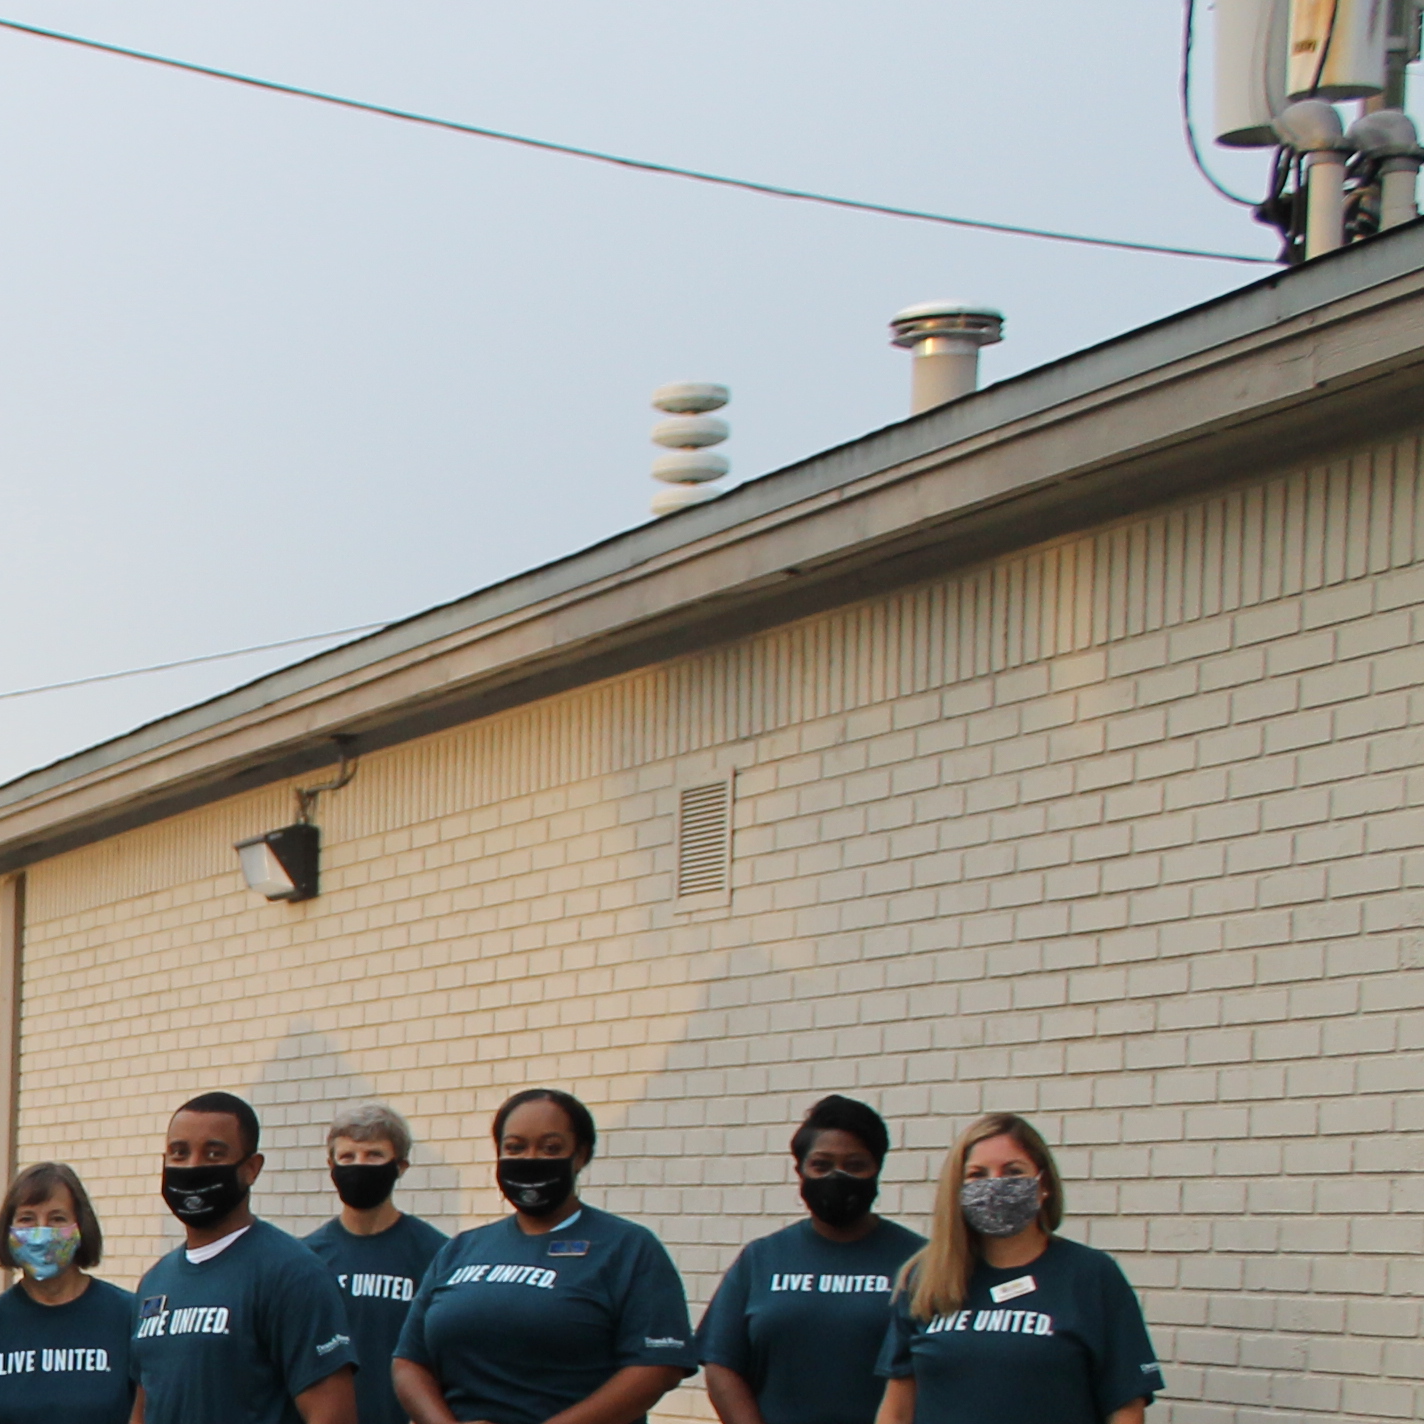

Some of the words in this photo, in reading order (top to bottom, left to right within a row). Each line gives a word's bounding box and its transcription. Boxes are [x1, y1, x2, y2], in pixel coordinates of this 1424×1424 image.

[351, 1273, 414, 1302] UNITED
[447, 1264, 491, 1286] LIVE
[770, 1273, 814, 1292] LIVE
[137, 1309, 170, 1339] LIVE
